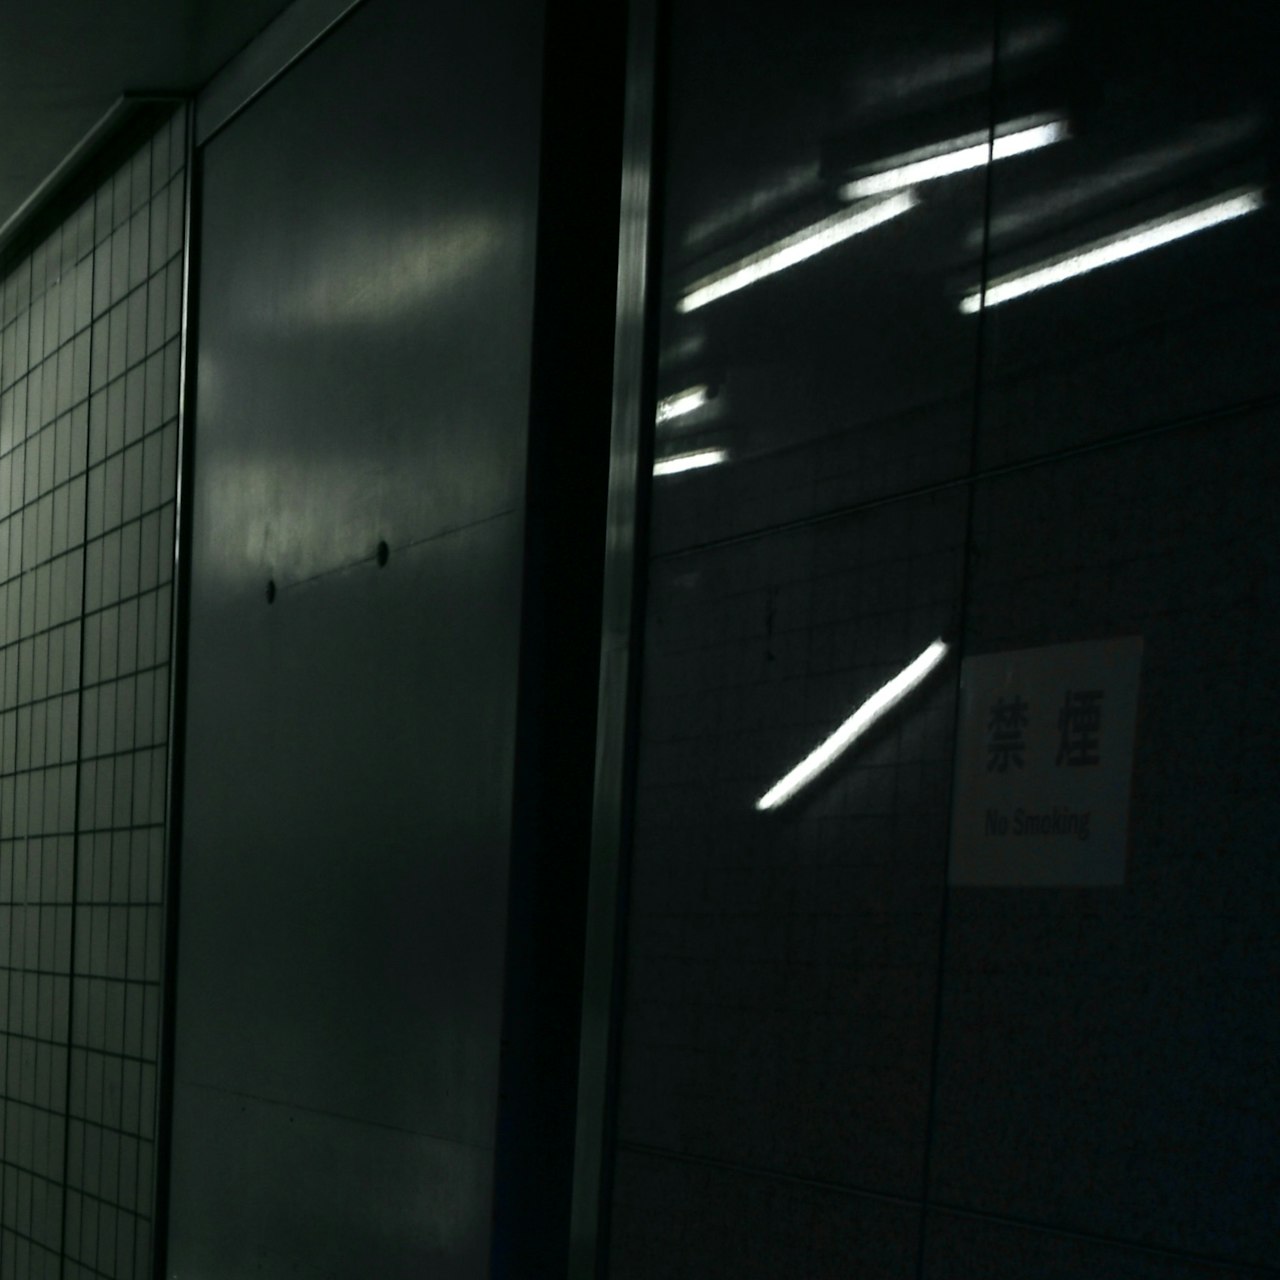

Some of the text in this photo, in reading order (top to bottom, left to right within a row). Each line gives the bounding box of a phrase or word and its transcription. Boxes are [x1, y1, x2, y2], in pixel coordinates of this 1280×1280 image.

[986, 689, 1105, 773] 禁煙
[985, 805, 1091, 841] No Smoking
